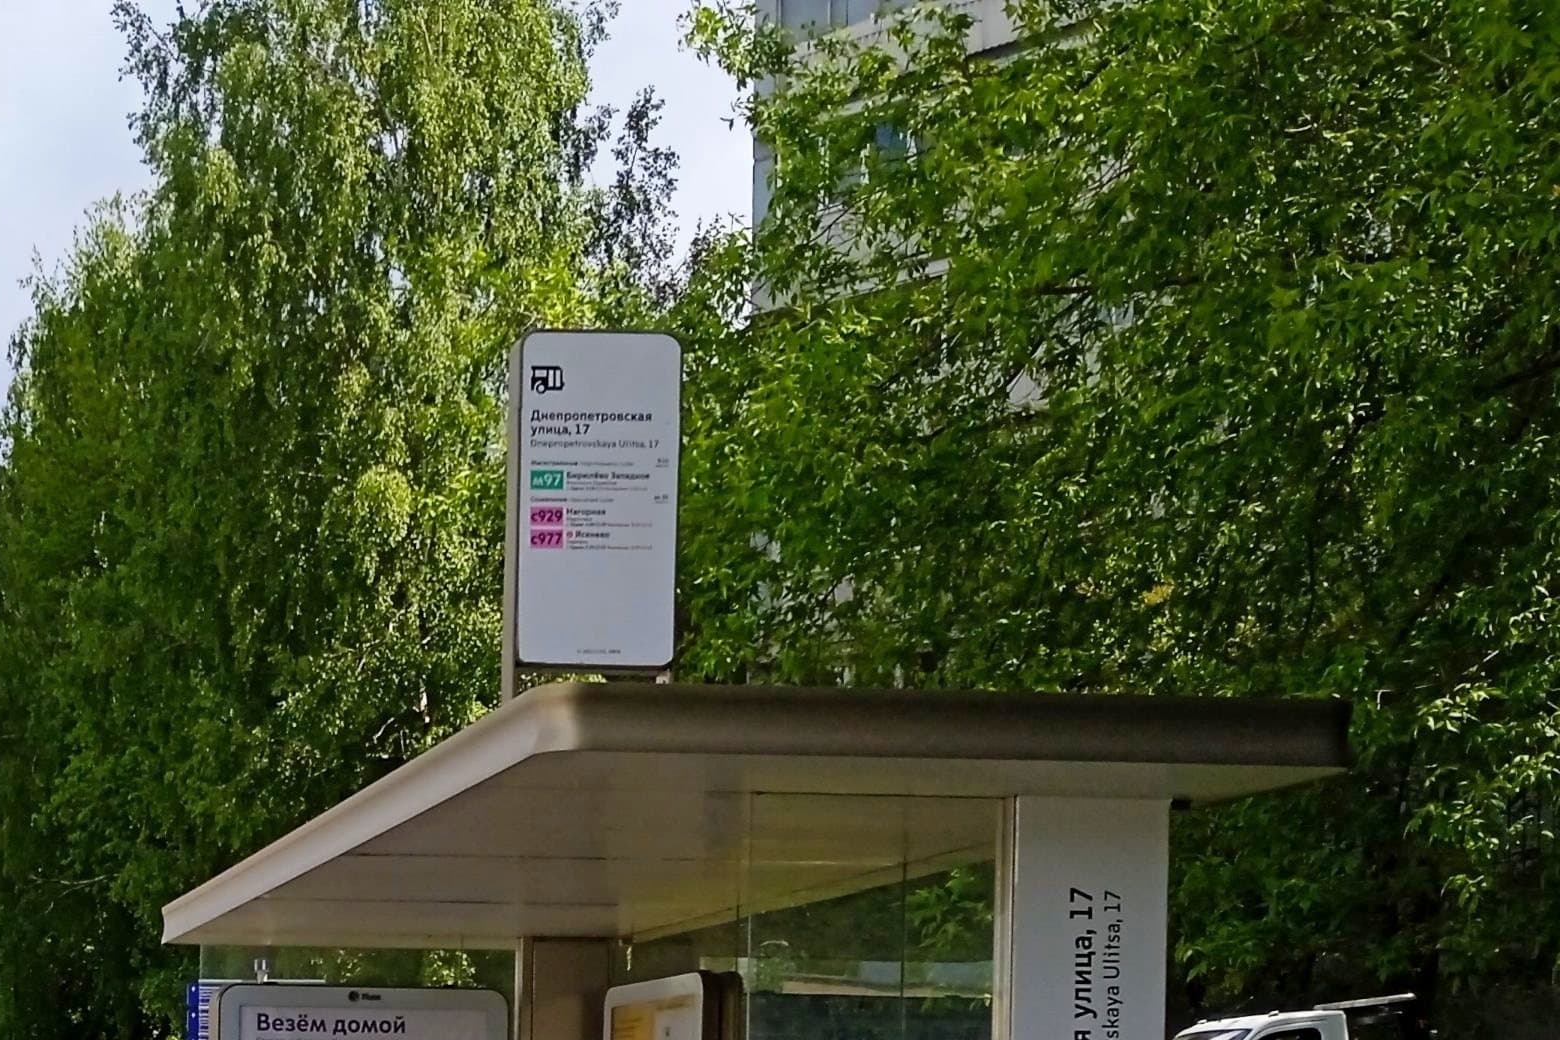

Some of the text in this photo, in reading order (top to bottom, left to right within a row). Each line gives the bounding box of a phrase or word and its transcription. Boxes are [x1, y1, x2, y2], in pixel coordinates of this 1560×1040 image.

[530, 409, 653, 423] Днепропетровская
[530, 423, 591, 437] улица, 17
[649, 440, 660, 449] 17
[532, 473, 563, 488] м97
[1069, 887, 1094, 920] 17
[1103, 890, 1122, 913] 17
[1102, 919, 1124, 980] Ulitsa,
[1073, 929, 1098, 1020] улица,
[256, 1013, 407, 1036] Везём домой
